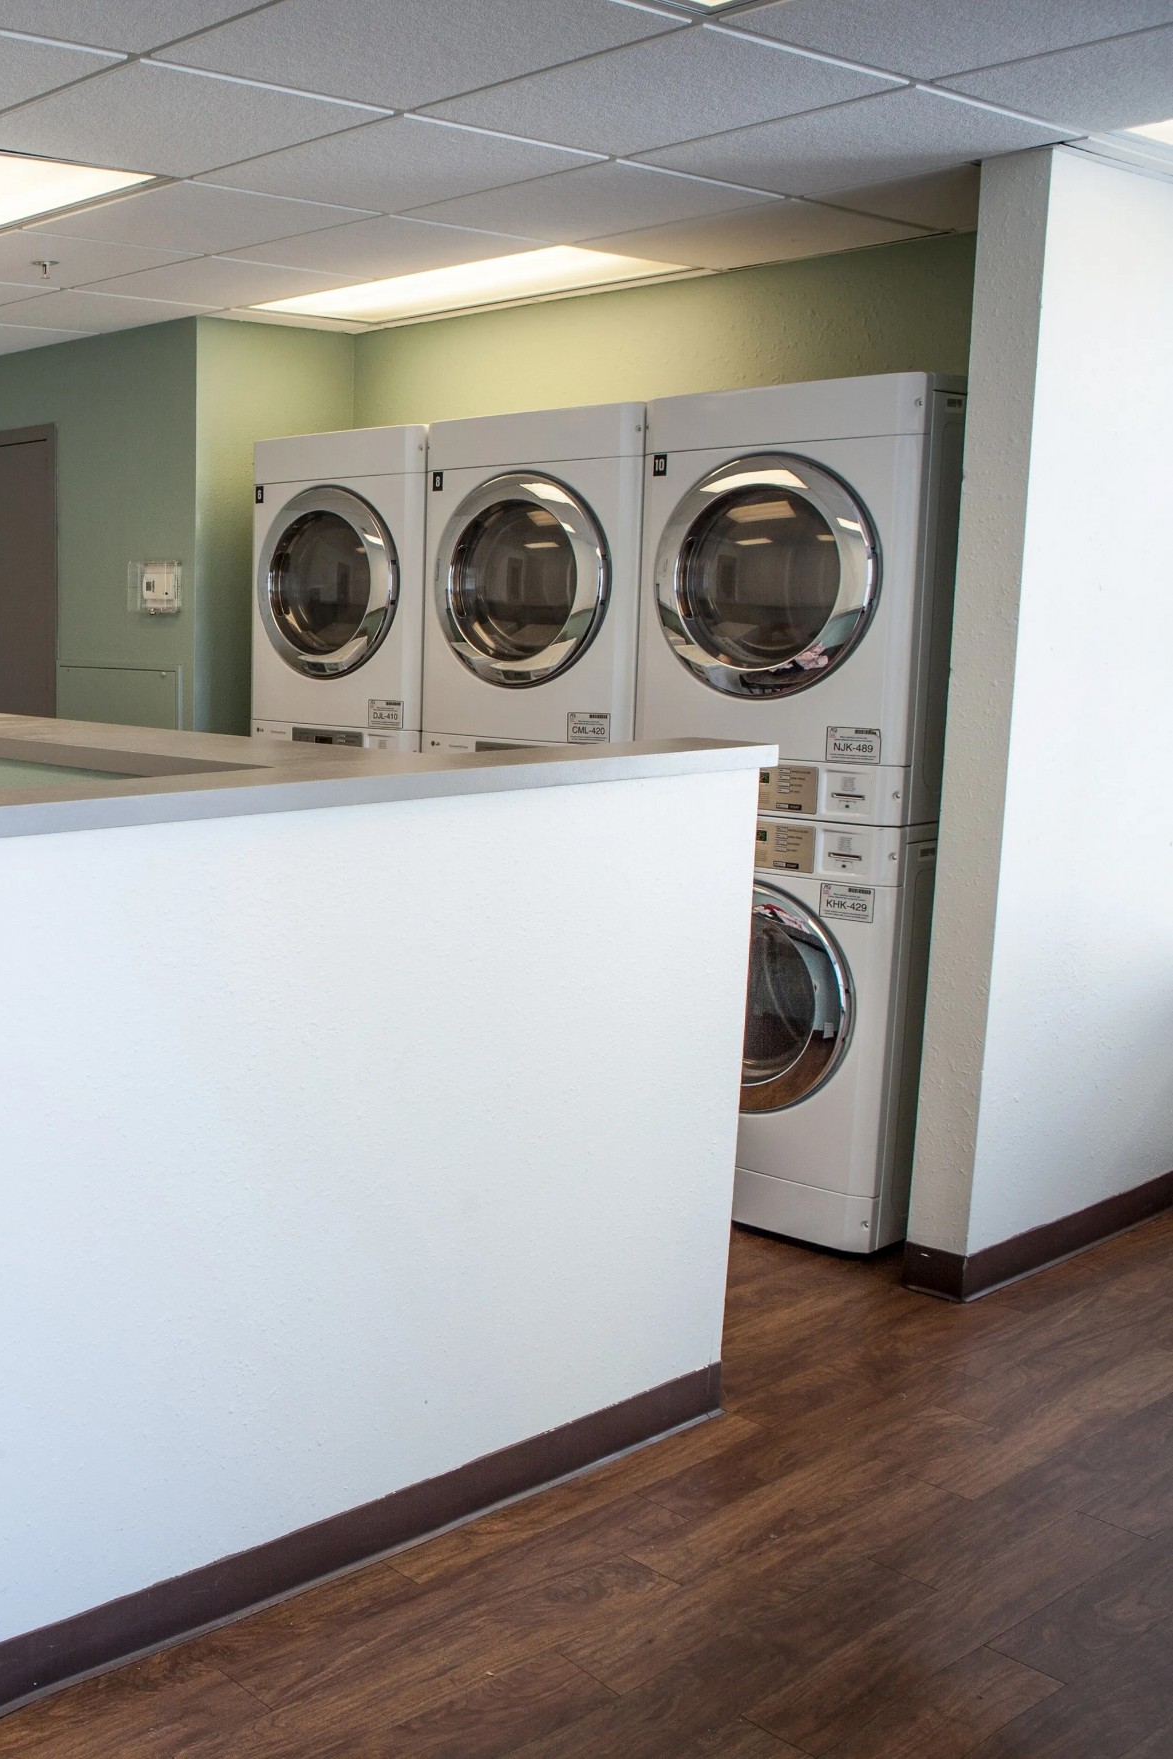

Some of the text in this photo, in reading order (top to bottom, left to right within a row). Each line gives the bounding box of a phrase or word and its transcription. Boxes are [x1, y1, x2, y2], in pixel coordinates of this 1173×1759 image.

[655, 459, 665, 471] 10
[435, 476, 441, 487] 8
[257, 489, 262, 500] 6
[373, 711, 398, 721] DJL-410
[572, 725, 605, 735] CML-420
[833, 742, 874, 753] NJK-489
[826, 899, 867, 912] KHK-429
